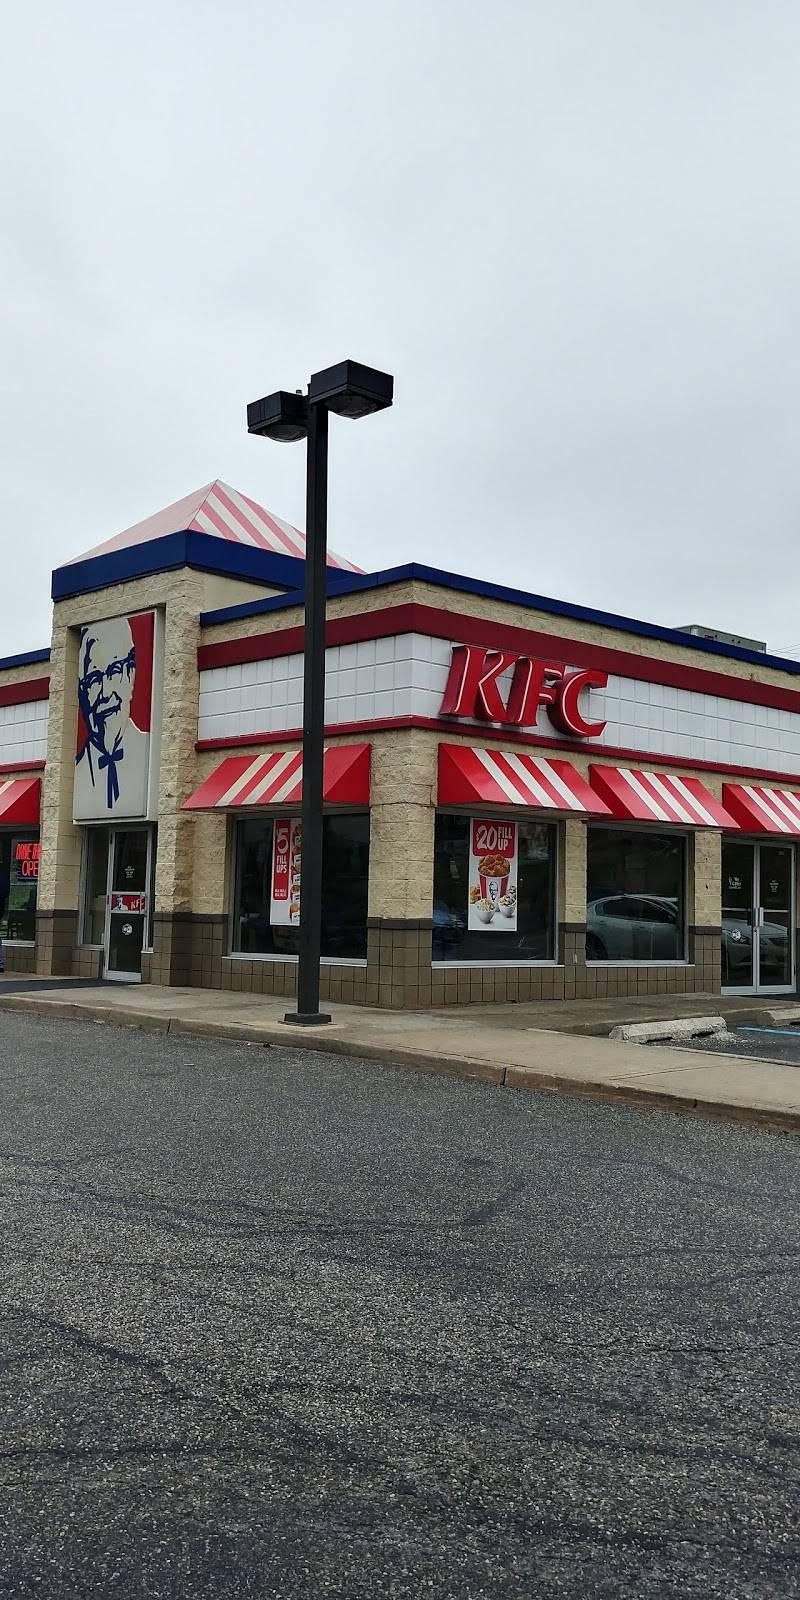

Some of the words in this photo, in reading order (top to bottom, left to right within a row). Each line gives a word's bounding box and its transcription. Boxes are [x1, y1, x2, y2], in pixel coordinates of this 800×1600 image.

[439, 644, 608, 737] KFC
[498, 827, 512, 839] FILL
[498, 839, 509, 851] UP
[276, 855, 287, 864] FILL
[22, 861, 39, 876] OPE
[276, 865, 287, 873] UPS
